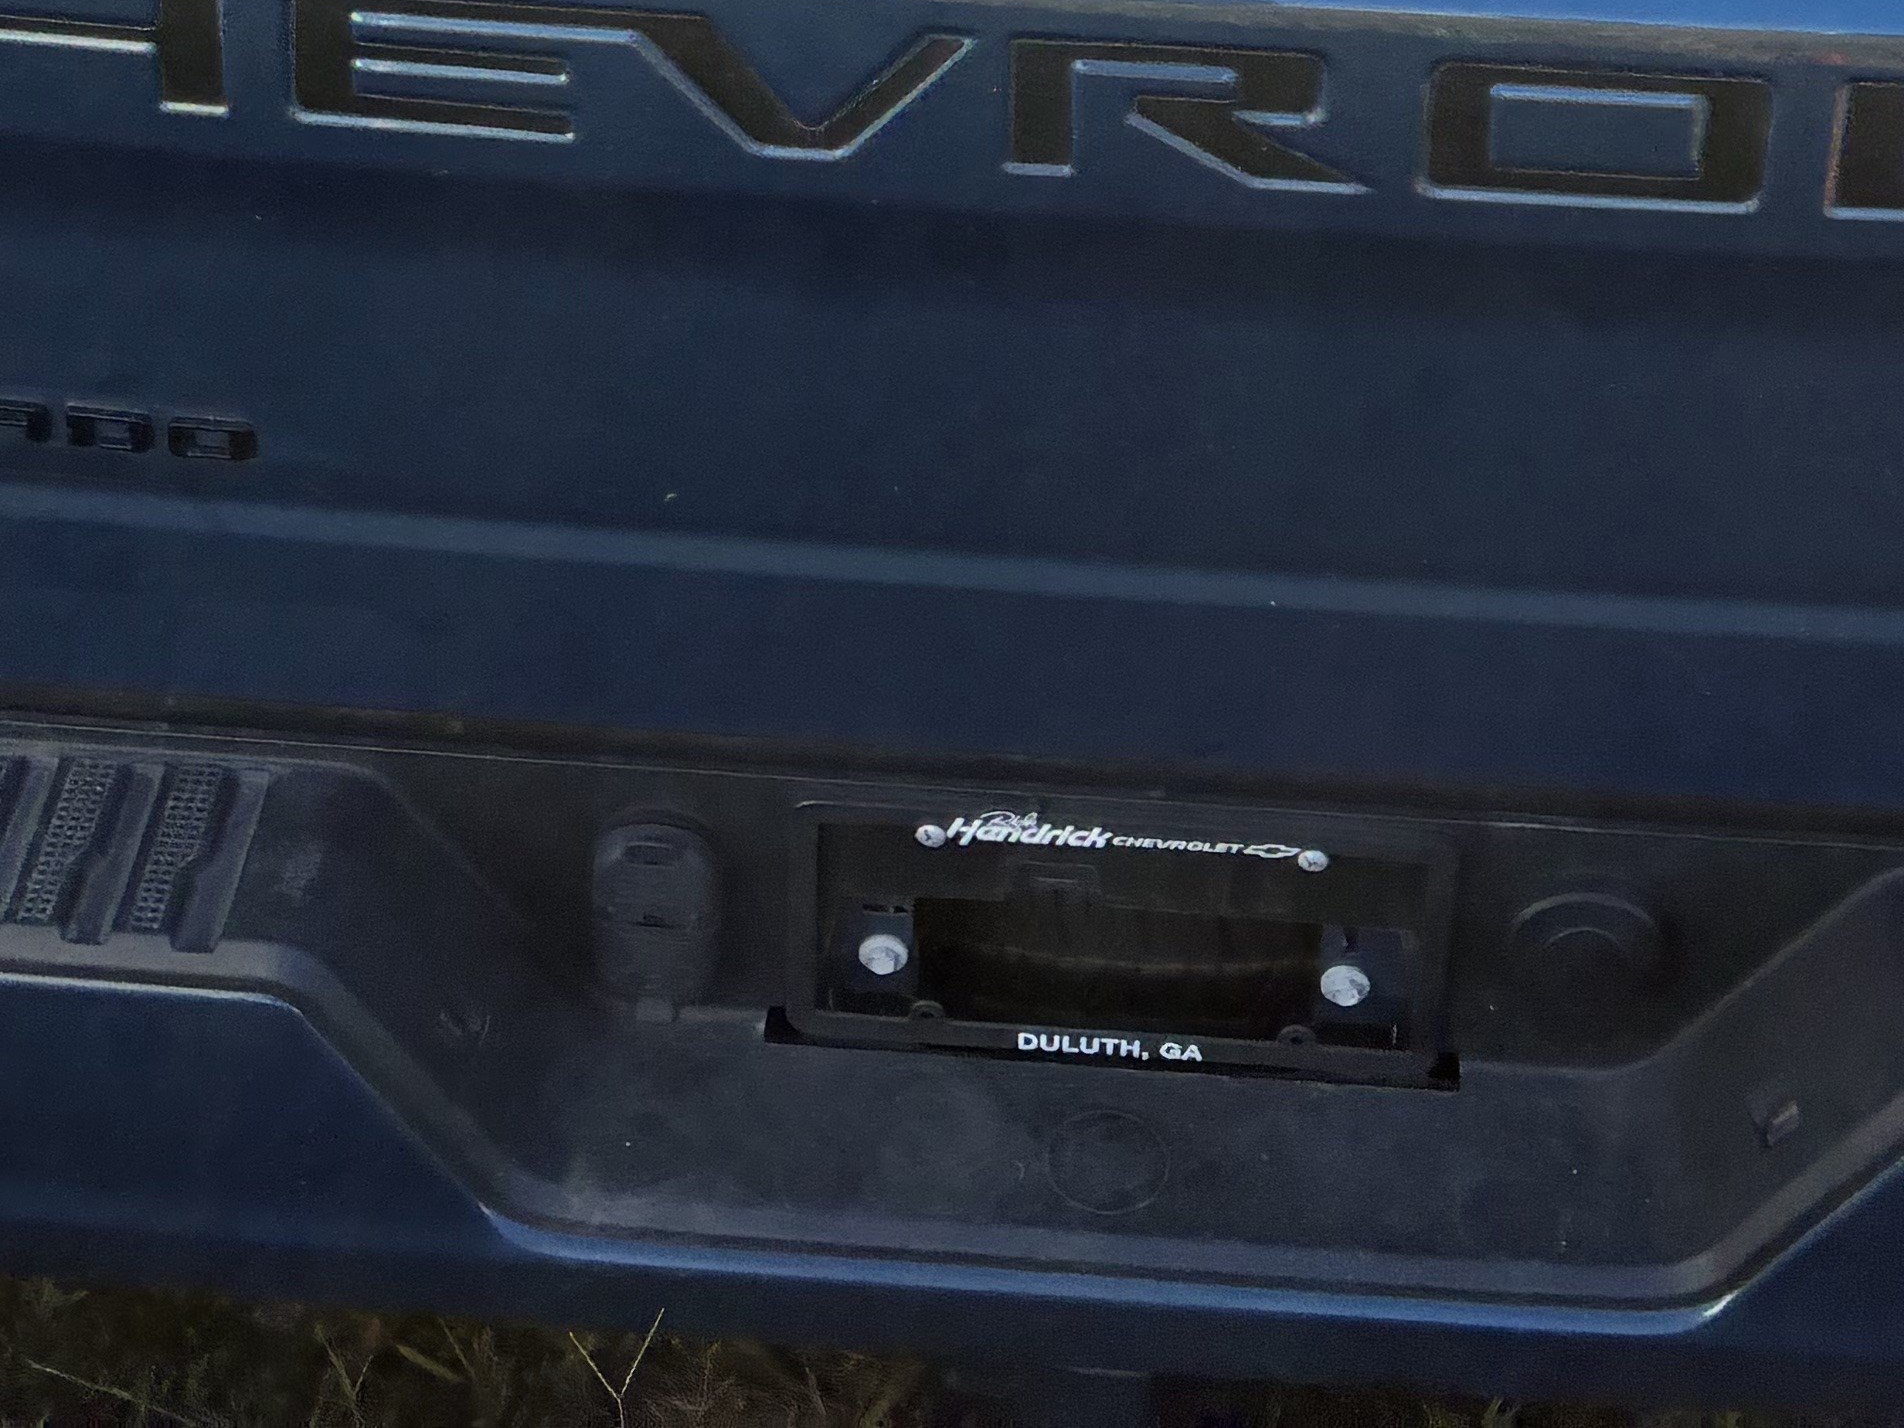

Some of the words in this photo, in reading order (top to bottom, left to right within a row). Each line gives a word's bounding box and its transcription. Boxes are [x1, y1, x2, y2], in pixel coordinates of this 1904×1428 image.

[946, 817, 1113, 849] Hendrick
[1112, 834, 1244, 854] CHEVROLET
[1017, 1032, 1150, 1061] DULUTH,
[1159, 1042, 1203, 1062] GA
